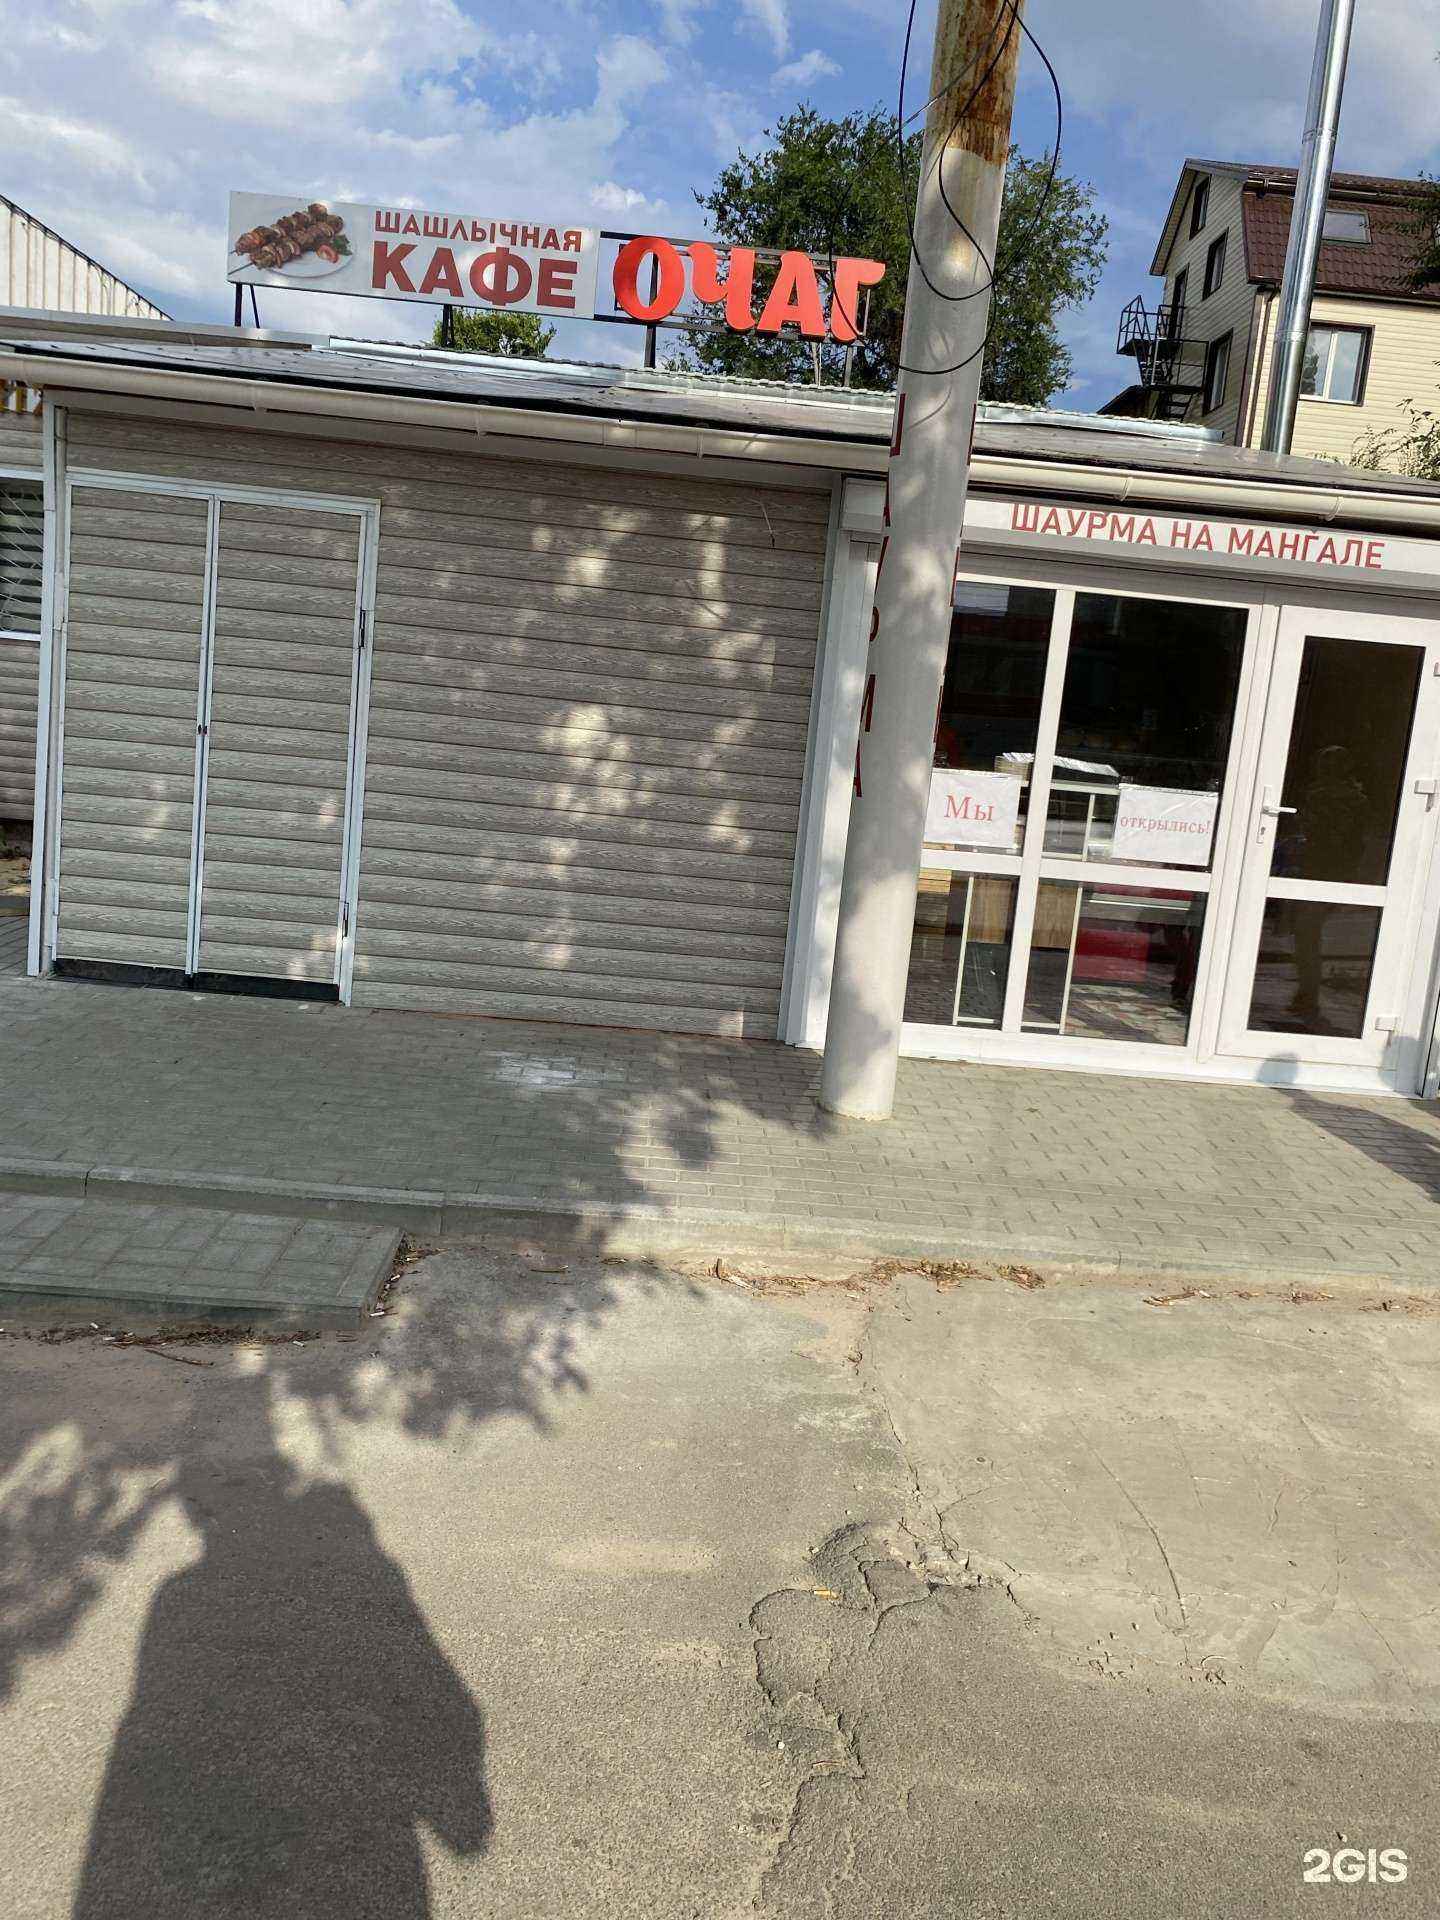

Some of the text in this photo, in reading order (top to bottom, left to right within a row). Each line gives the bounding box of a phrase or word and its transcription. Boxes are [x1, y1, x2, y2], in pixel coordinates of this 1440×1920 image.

[375, 210, 583, 253] ШАШЛЫЧНАЯ
[371, 240, 579, 310] КАФЕ
[612, 236, 886, 344] ОЧАГ
[1010, 502, 1386, 570] ШАУРМА НА МАНГАЛЕ
[943, 793, 994, 822] Мы
[1119, 814, 1213, 835] открылись!
